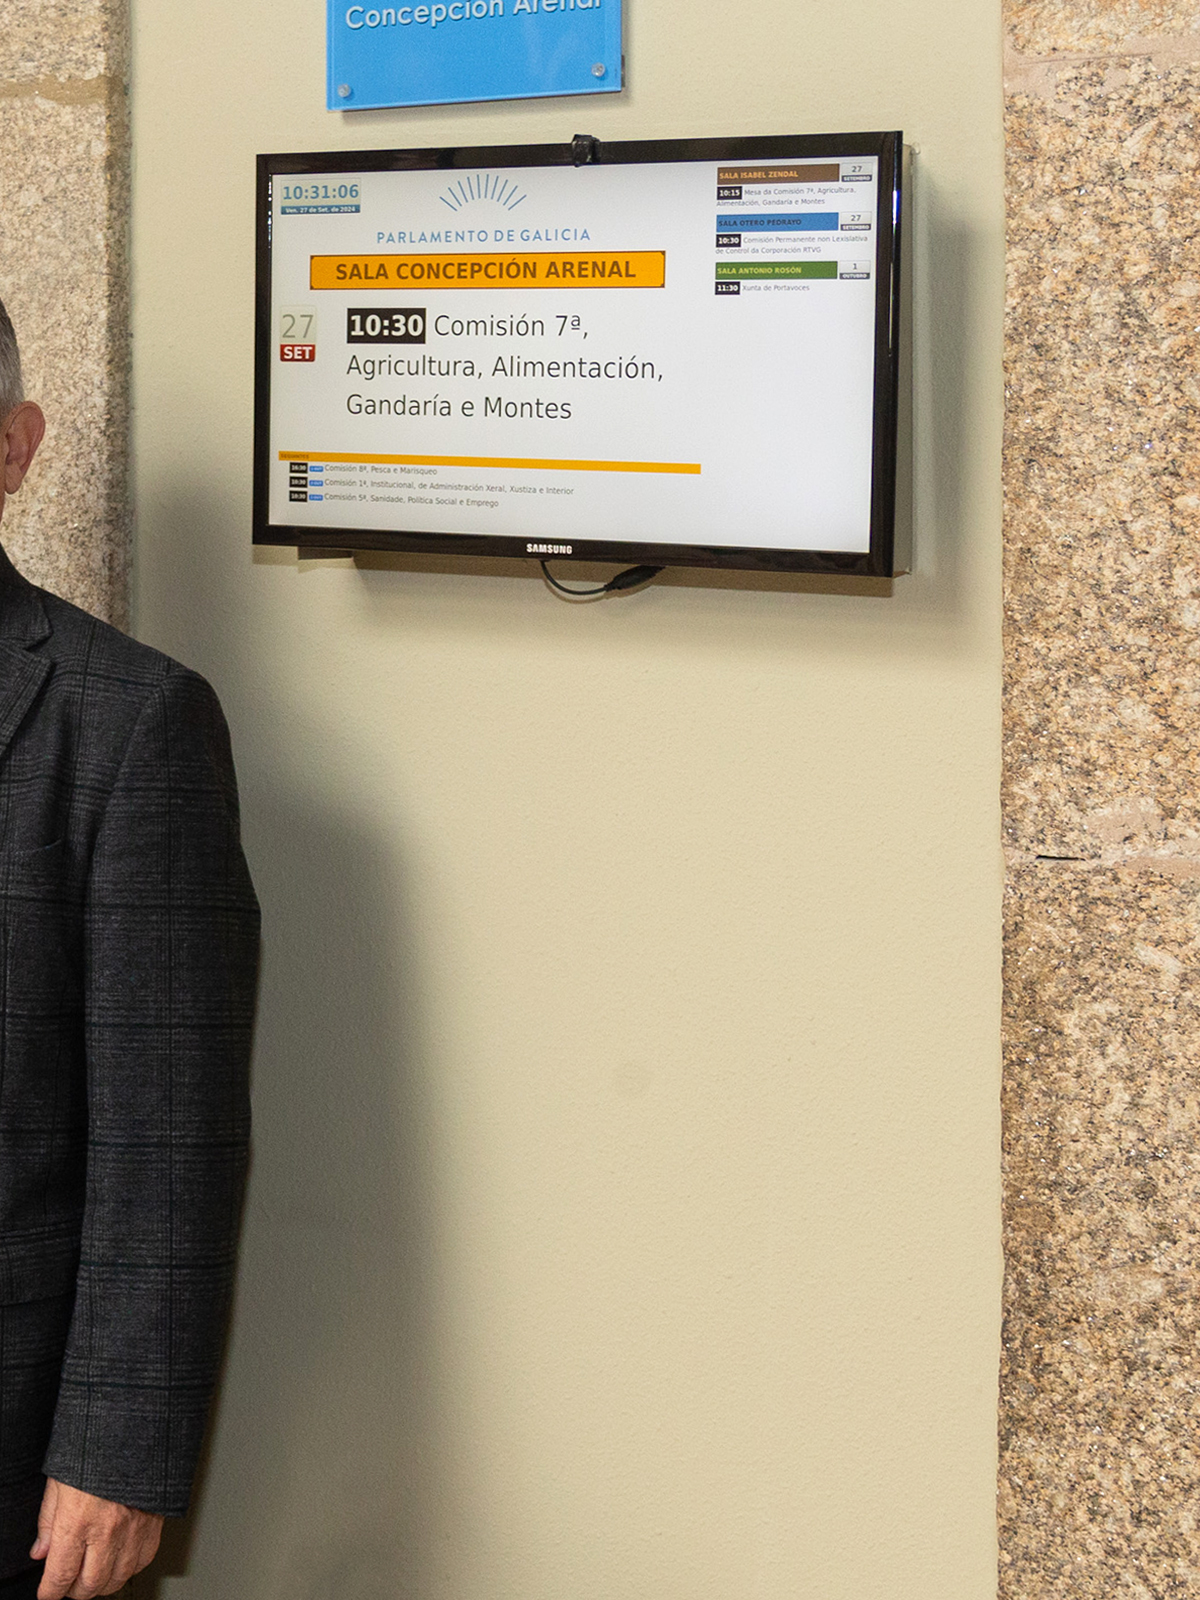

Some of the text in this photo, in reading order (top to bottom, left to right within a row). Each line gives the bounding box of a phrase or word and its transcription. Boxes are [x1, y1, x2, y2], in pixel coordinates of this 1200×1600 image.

[719, 170, 799, 180] SALA ISABEL ZENDAL
[851, 165, 862, 173] 27
[283, 184, 359, 200] 10:31:06
[719, 189, 741, 197] 10:15
[763, 188, 772, 196] da
[773, 187, 804, 196] Comisión
[800, 197, 825, 206] Montes
[340, 205, 356, 213] 2024
[718, 217, 802, 227] SALA OTERO PEDRAYO
[850, 214, 862, 222] 27
[376, 228, 591, 244] PARLAMENTO DE GALICIA
[718, 237, 740, 245] 10:30
[743, 235, 774, 244] Comisión
[775, 236, 816, 244] Permanente
[832, 235, 868, 243] Lexislativa
[715, 246, 821, 256] de Control da Corporación RTVG
[335, 258, 636, 280] SALA CONCEPCIÓN ARENAL
[717, 267, 737, 275] SALA
[738, 267, 772, 275] ANTONIO
[717, 284, 810, 292] 11:30 Xunta de Portavoces
[281, 314, 314, 339] 27
[350, 312, 589, 340] 10:30 Comisión 7ª,
[283, 346, 313, 360] SET
[346, 354, 664, 382] Agricultura, Alimentación,
[346, 392, 572, 420] Gandaría e Montes
[324, 464, 357, 472] Comisión
[371, 466, 391, 474] Pesca
[400, 467, 438, 476] Marisqueo
[324, 478, 357, 487] Comisión
[429, 482, 484, 492] Administración
[509, 485, 537, 494] Xustiza
[546, 487, 574, 495] Interior
[324, 493, 357, 501] Comisión
[435, 497, 457, 506] Social
[466, 498, 499, 508] Emprego
[526, 543, 572, 555] SAMSUNG
